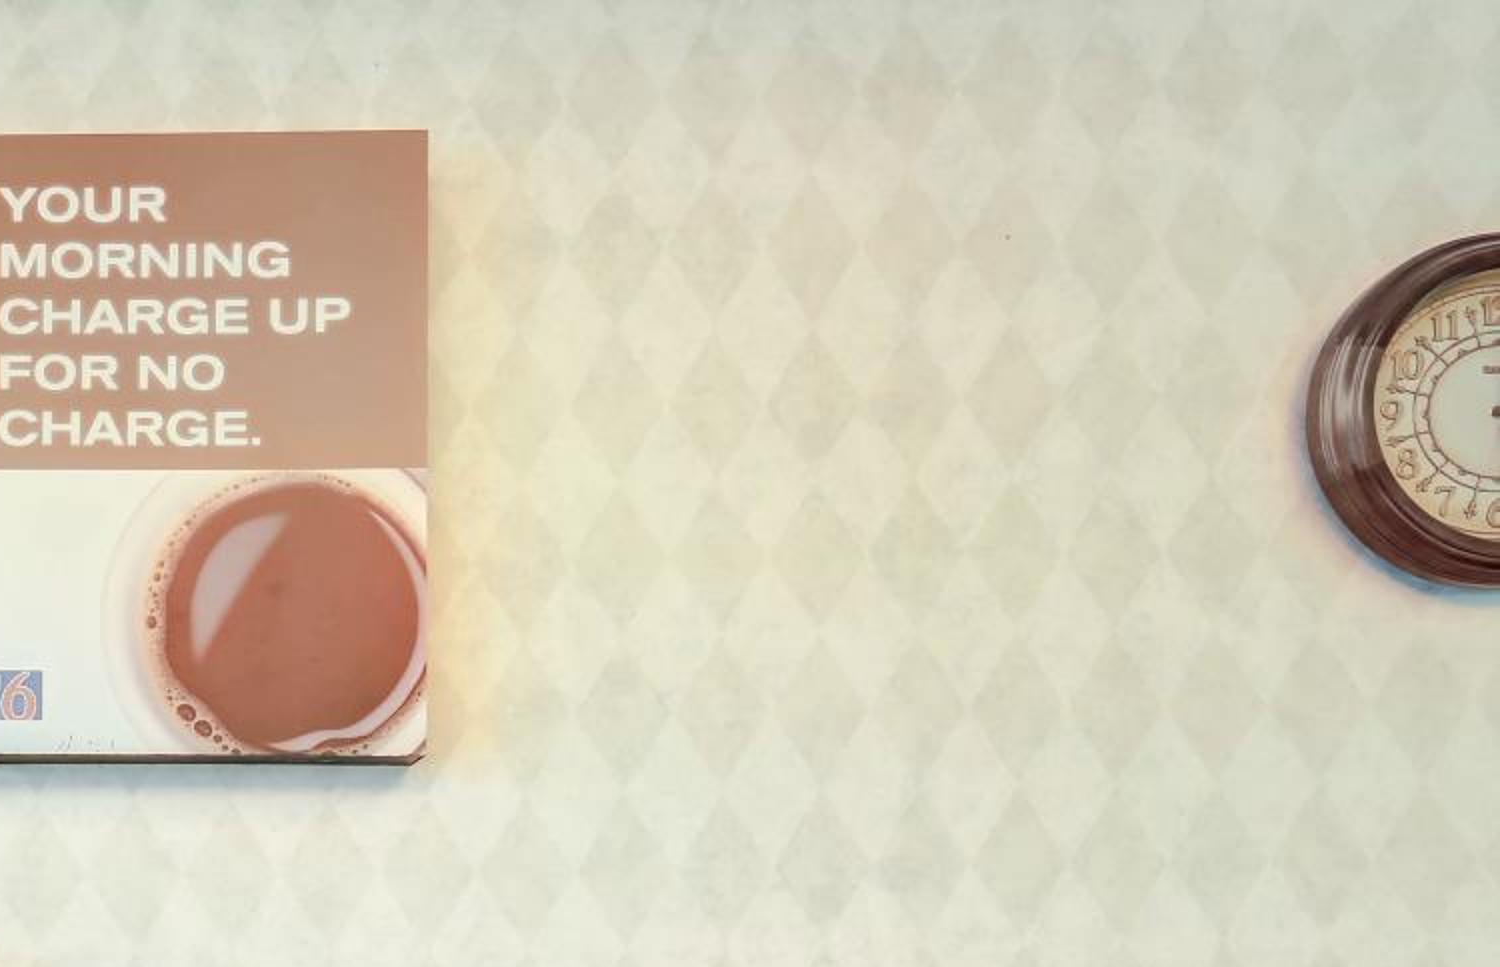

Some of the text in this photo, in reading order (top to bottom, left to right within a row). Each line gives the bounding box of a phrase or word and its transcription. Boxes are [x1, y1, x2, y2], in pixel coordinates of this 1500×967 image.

[0, 241, 291, 279] MORNING
[270, 297, 351, 334] UP
[1431, 311, 1459, 342] 11
[139, 354, 226, 391] NO
[1390, 350, 1423, 381] 10
[1380, 401, 1399, 431] 9
[1396, 449, 1416, 480] 8
[1435, 486, 1457, 517] 7
[0, 671, 37, 720] 6
